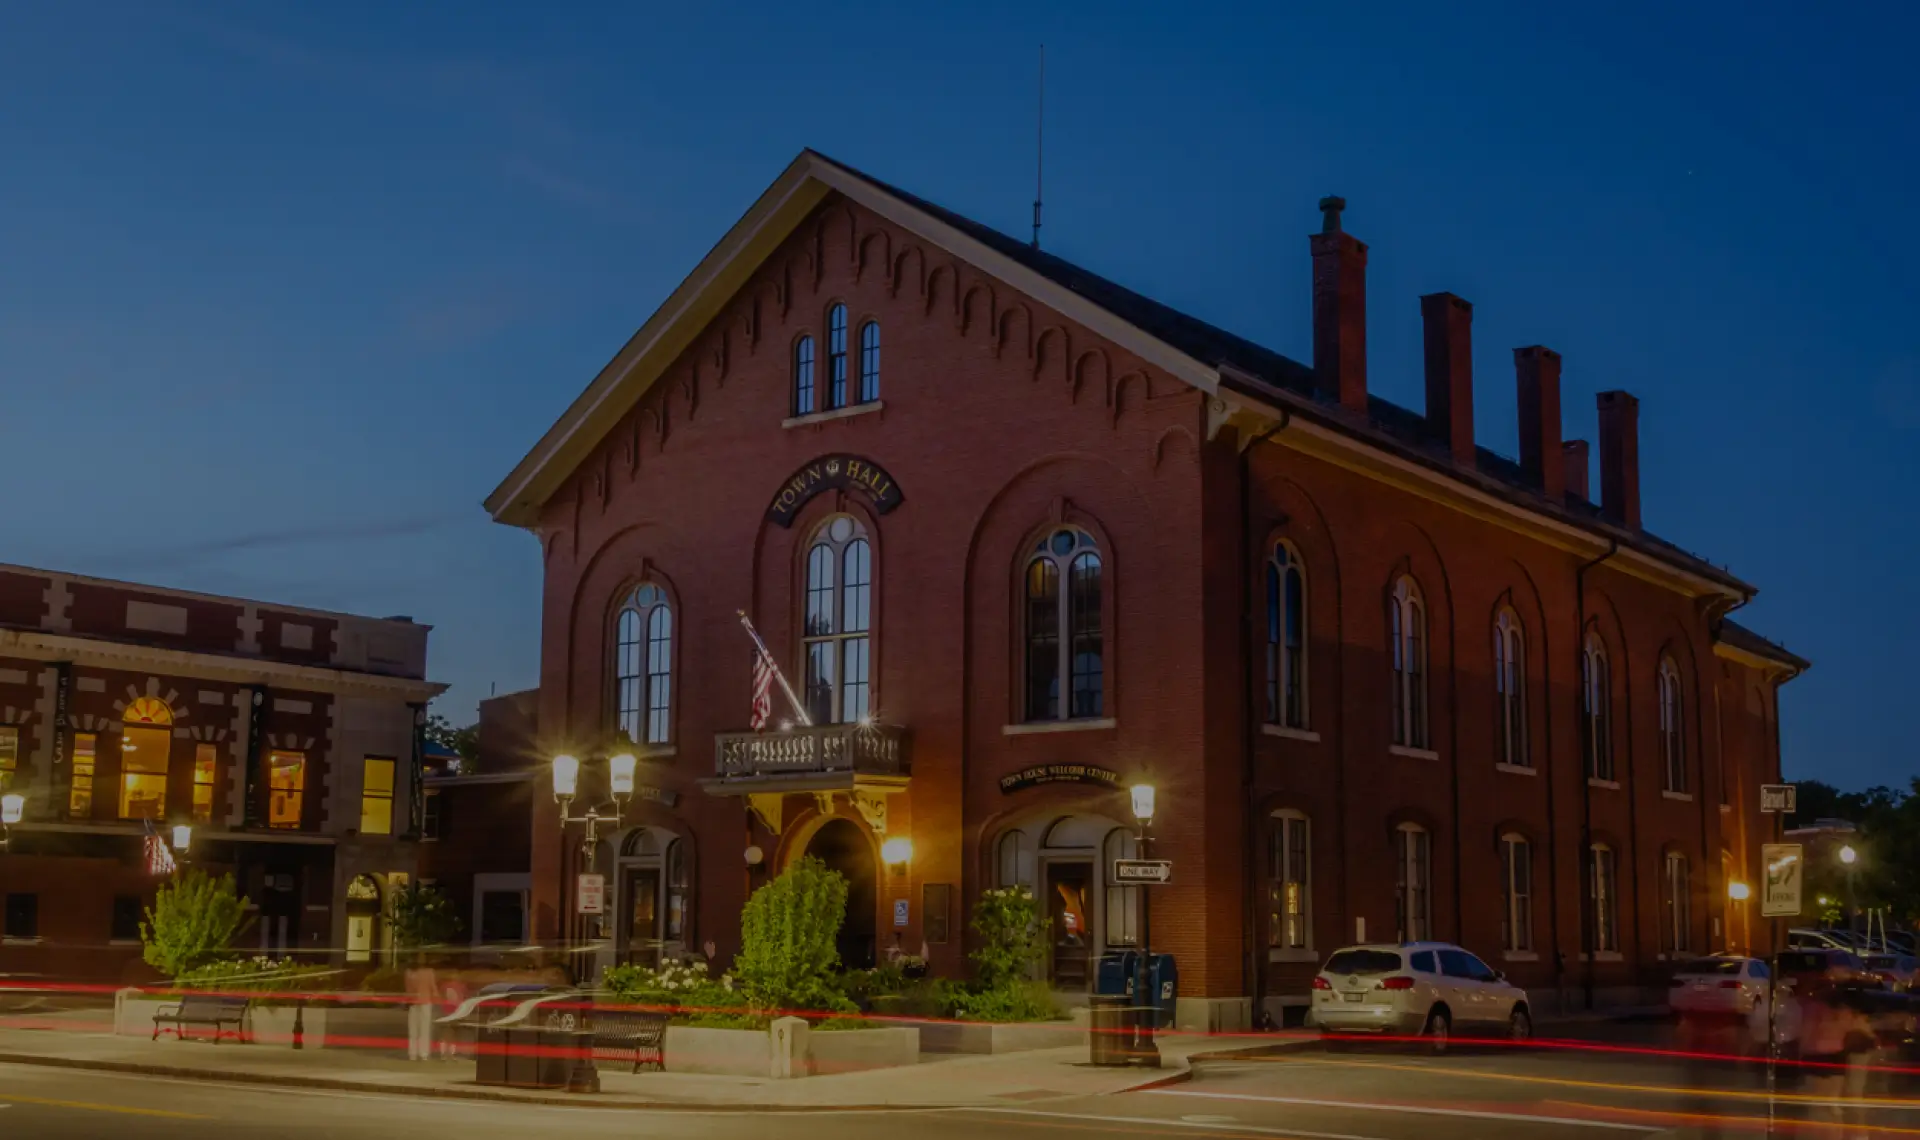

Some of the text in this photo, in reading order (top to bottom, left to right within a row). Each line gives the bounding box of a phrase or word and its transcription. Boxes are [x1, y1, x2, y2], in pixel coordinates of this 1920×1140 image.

[772, 460, 891, 514] TOWN HALL
[1001, 773, 1022, 789] TOWN
[1023, 766, 1048, 780] HOUSE
[1049, 765, 1085, 775] WELCOME
[1087, 767, 1117, 781] CENTER
[1122, 866, 1159, 876] ONE WAY
